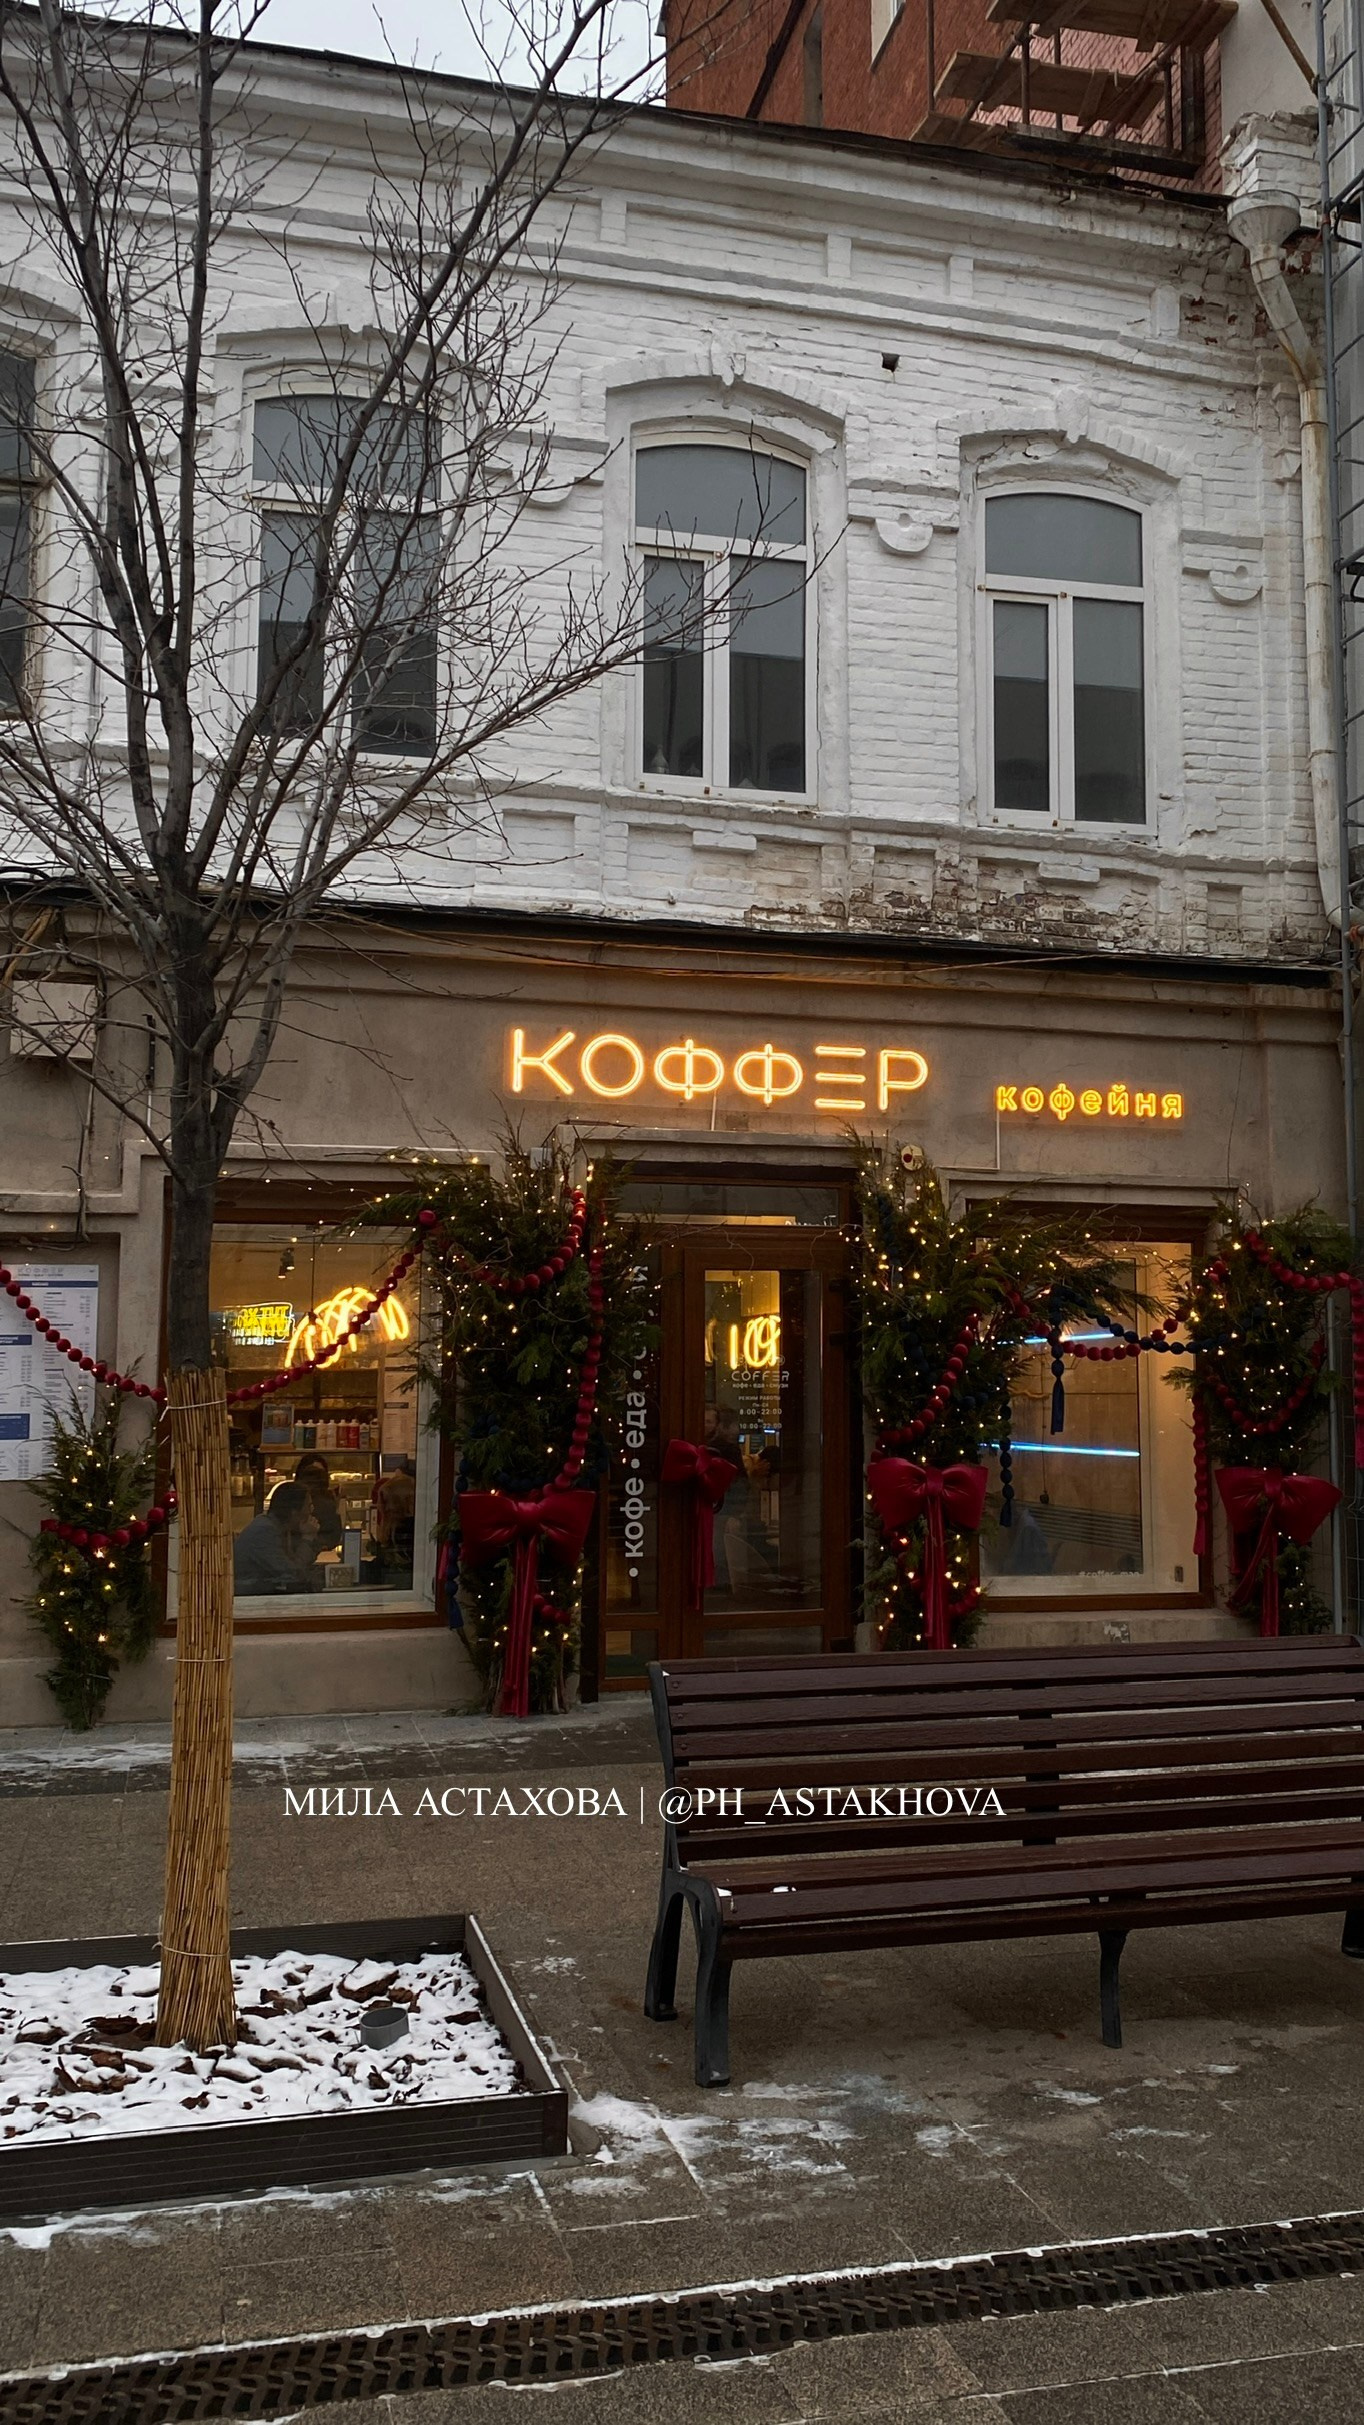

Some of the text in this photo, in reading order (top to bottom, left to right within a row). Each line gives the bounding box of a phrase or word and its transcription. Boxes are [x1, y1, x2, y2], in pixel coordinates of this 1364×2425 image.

[511, 1027, 931, 1113] КОФФЕР
[996, 1083, 1184, 1121] кофейня
[731, 1371, 789, 1382] COFFER
[626, 1391, 647, 1449] еда
[620, 1477, 650, 1558] кофе
